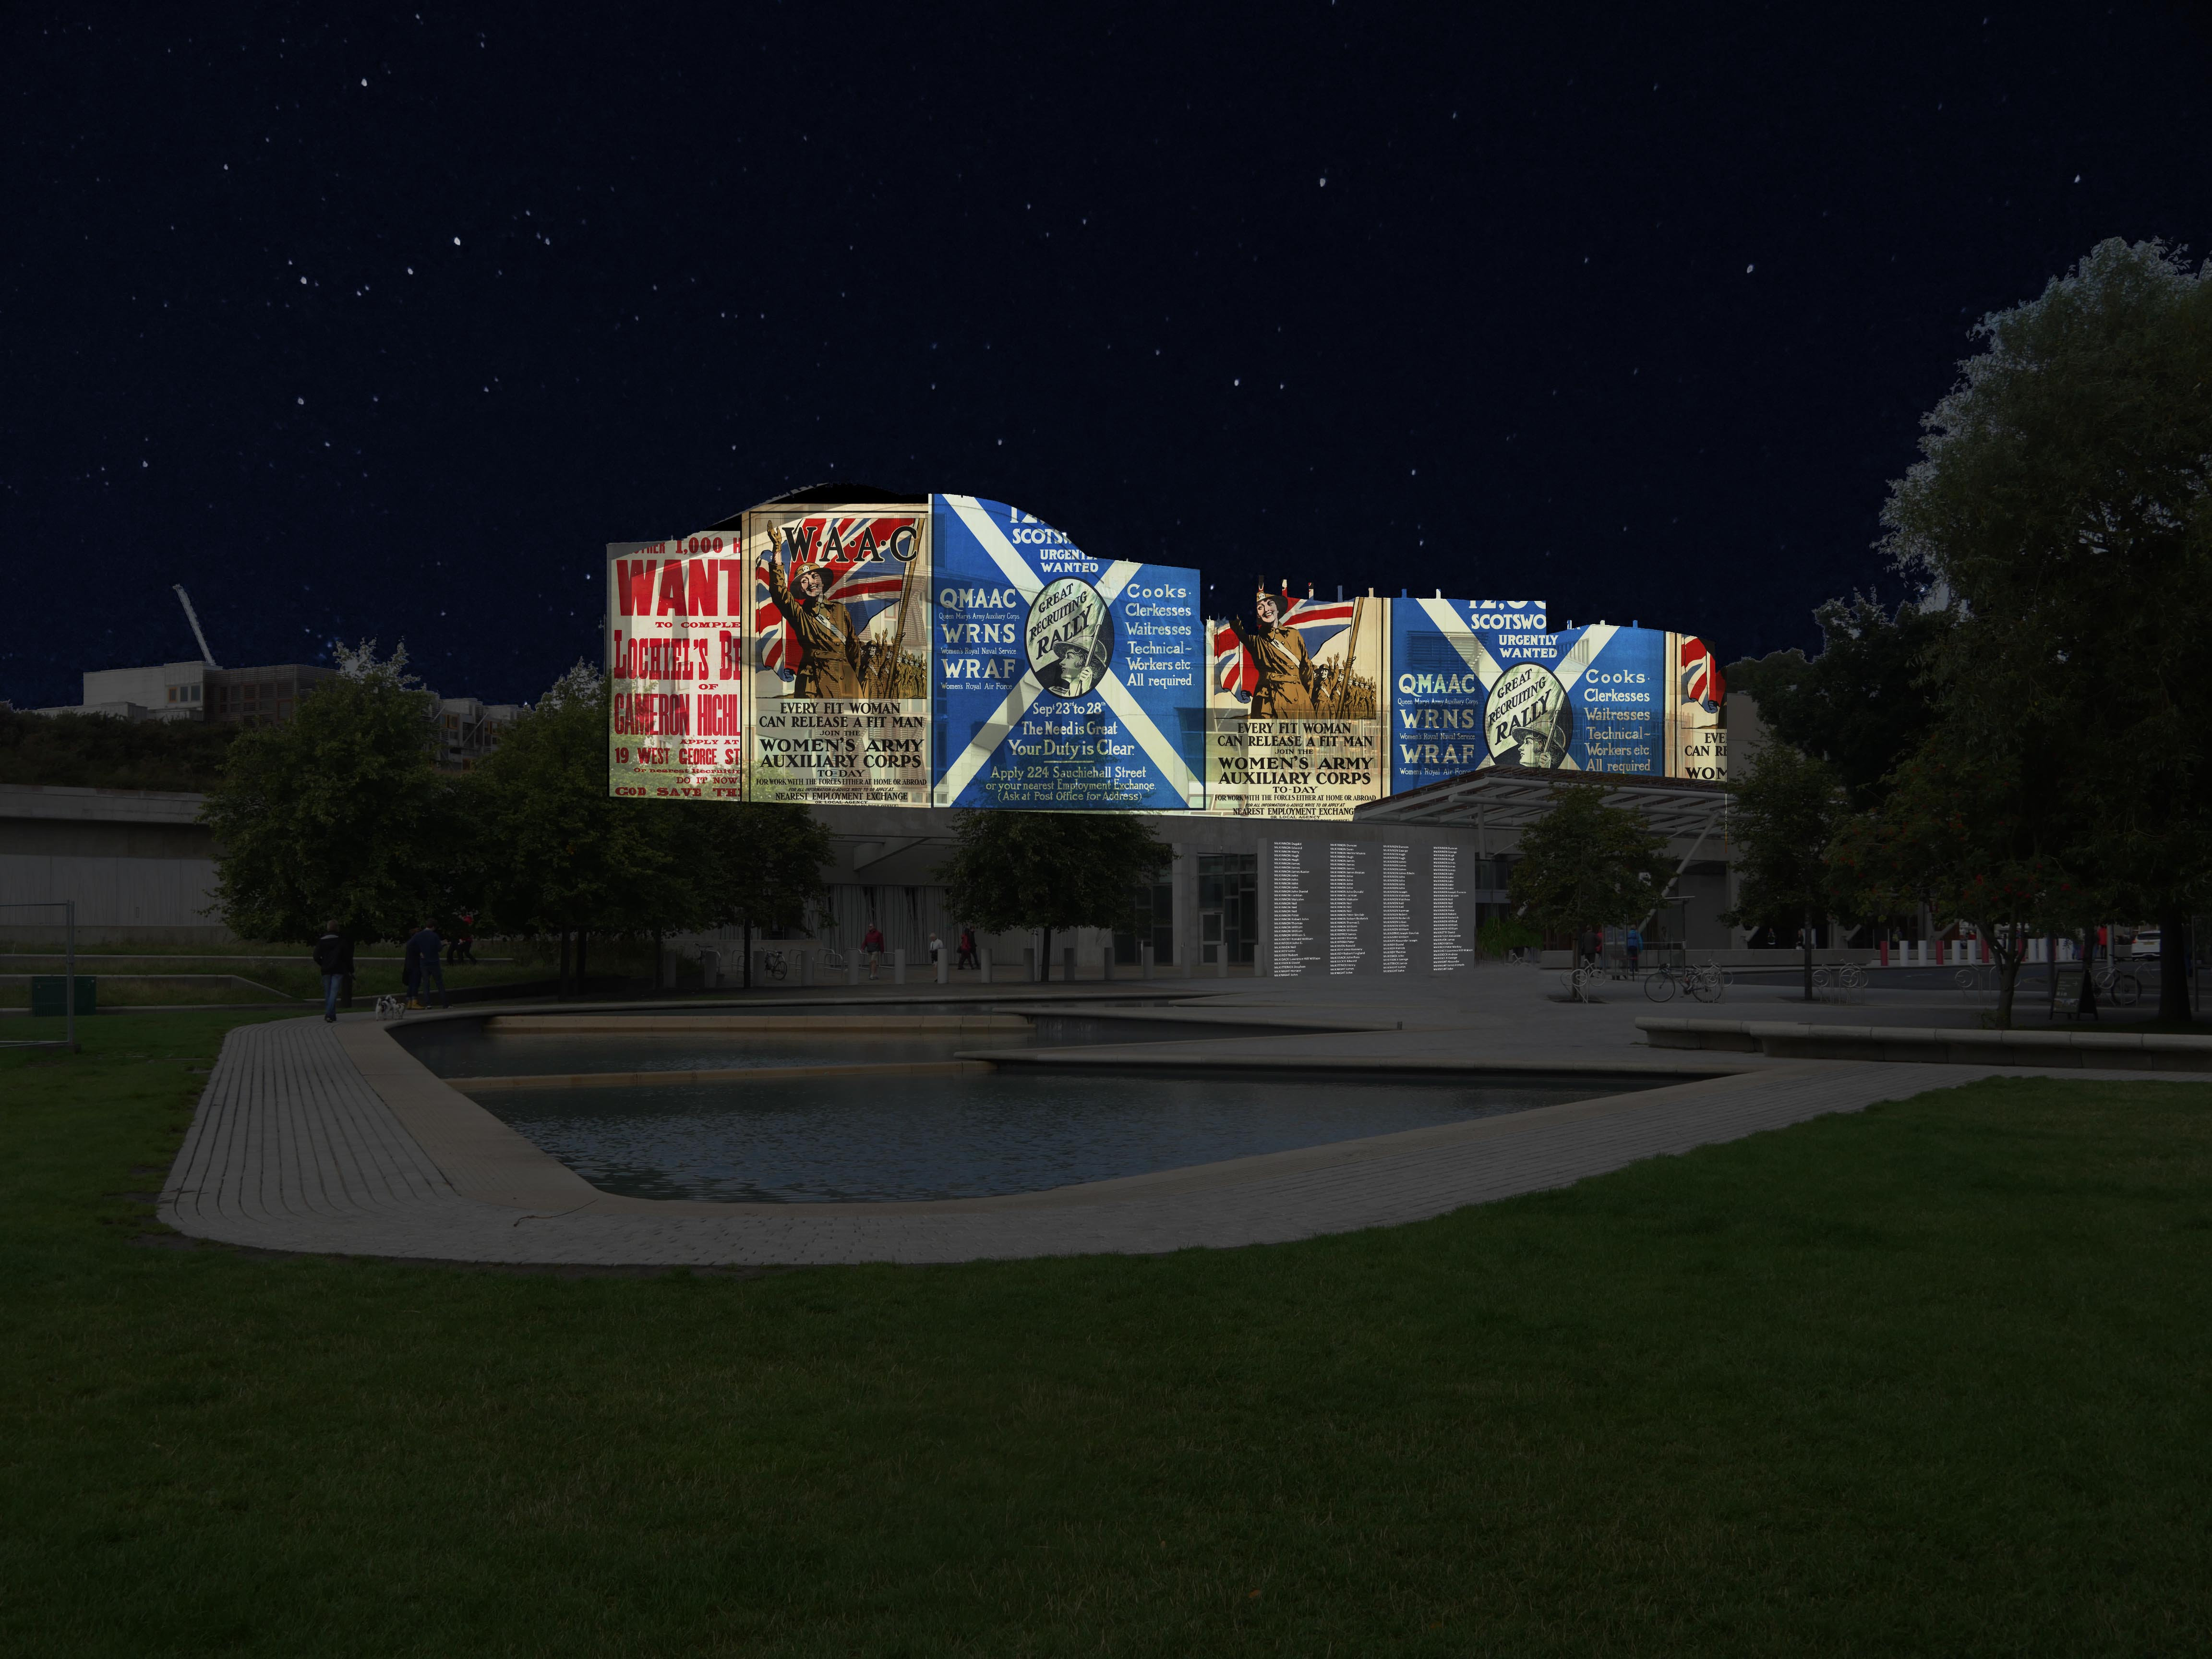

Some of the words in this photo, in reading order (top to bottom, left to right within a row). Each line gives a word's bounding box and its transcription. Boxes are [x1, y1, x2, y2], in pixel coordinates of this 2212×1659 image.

[675, 537, 723, 554] 1,000
[1041, 562, 1099, 573] WANTED
[616, 559, 740, 616] WANT
[1038, 583, 1073, 613] GREAT
[1125, 602, 1191, 616] Clerkesses
[939, 613, 954, 621] Queen
[956, 613, 971, 621] Mary's
[972, 613, 986, 621] Army
[986, 613, 1006, 621] Auxiliary
[1007, 613, 1020, 622] Corps
[1029, 591, 1088, 642] RECRUITING
[1471, 613, 1546, 629] SCOTSWO
[1035, 603, 1093, 660] RALLY
[1125, 622, 1191, 636] Waitresses
[1499, 635, 1559, 645] URGENTLY
[965, 647, 980, 656] Royal
[1499, 648, 1557, 658] WANTED
[1125, 657, 1173, 670] Workers
[965, 682, 981, 691] Royal
[1126, 673, 1144, 686] All
[1497, 668, 1532, 698] GREAT
[1488, 676, 1546, 727] RECRUITING
[1584, 688, 1650, 702] Clerkesses
[614, 693, 690, 735] CAMERON
[780, 702, 818, 714] EVERY
[824, 702, 843, 714] FIT
[849, 702, 901, 714] WOMAN
[1073, 703, 1085, 714] to
[1583, 707, 1651, 721] Waitresses
[759, 716, 786, 727] CAN
[791, 716, 848, 727] RELEASE
[852, 716, 863, 727] A
[867, 716, 887, 727] FIT
[891, 716, 923, 727] MAN
[1495, 688, 1552, 745] RALLY
[1022, 721, 1044, 735] The
[1045, 721, 1073, 735] Need
[1075, 722, 1085, 735] is
[1086, 721, 1118, 735] Great
[1238, 723, 1274, 733] EVERY
[1279, 723, 1298, 733] FIT
[1303, 723, 1352, 733] WOMAN
[759, 737, 856, 752] WOMEN'S
[864, 739, 925, 752] ARMY
[1218, 735, 1243, 746] CAN
[1248, 735, 1302, 746] RELEASE
[1305, 735, 1316, 746] A
[1319, 735, 1338, 746] FIT
[1343, 735, 1373, 746] MAN
[615, 747, 629, 763] 19
[637, 747, 671, 764] WEST
[679, 748, 717, 765] GEORGE
[1008, 739, 1042, 755] Your
[1043, 739, 1081, 760] Duty
[1082, 741, 1094, 755] is
[1685, 745, 1710, 757] CAN
[760, 754, 859, 768] AUXILIARY
[863, 754, 922, 768] CORPS
[1218, 756, 1310, 769] WOMEN'S
[1317, 757, 1374, 769] ARMY
[990, 766, 1025, 781] Apply
[1027, 766, 1049, 778] 224
[1053, 766, 1111, 778] Sauchiehall
[1115, 766, 1146, 778] Street
[1218, 772, 1312, 784] AUXILIARY
[1316, 772, 1371, 785] CORPS
[615, 787, 647, 796] GOD
[657, 788, 702, 797] SAVE
[998, 782, 1022, 793] your
[1022, 781, 1055, 790] nearest
[1057, 778, 1111, 792] Employment
[776, 792, 809, 800] NEAREST
[812, 792, 864, 800] EMPLOYMENT
[866, 792, 908, 800] EXCHANGE
[1022, 792, 1031, 801] at
[1034, 791, 1054, 801] Post
[1056, 791, 1084, 801] Office
[1086, 792, 1101, 801] for
